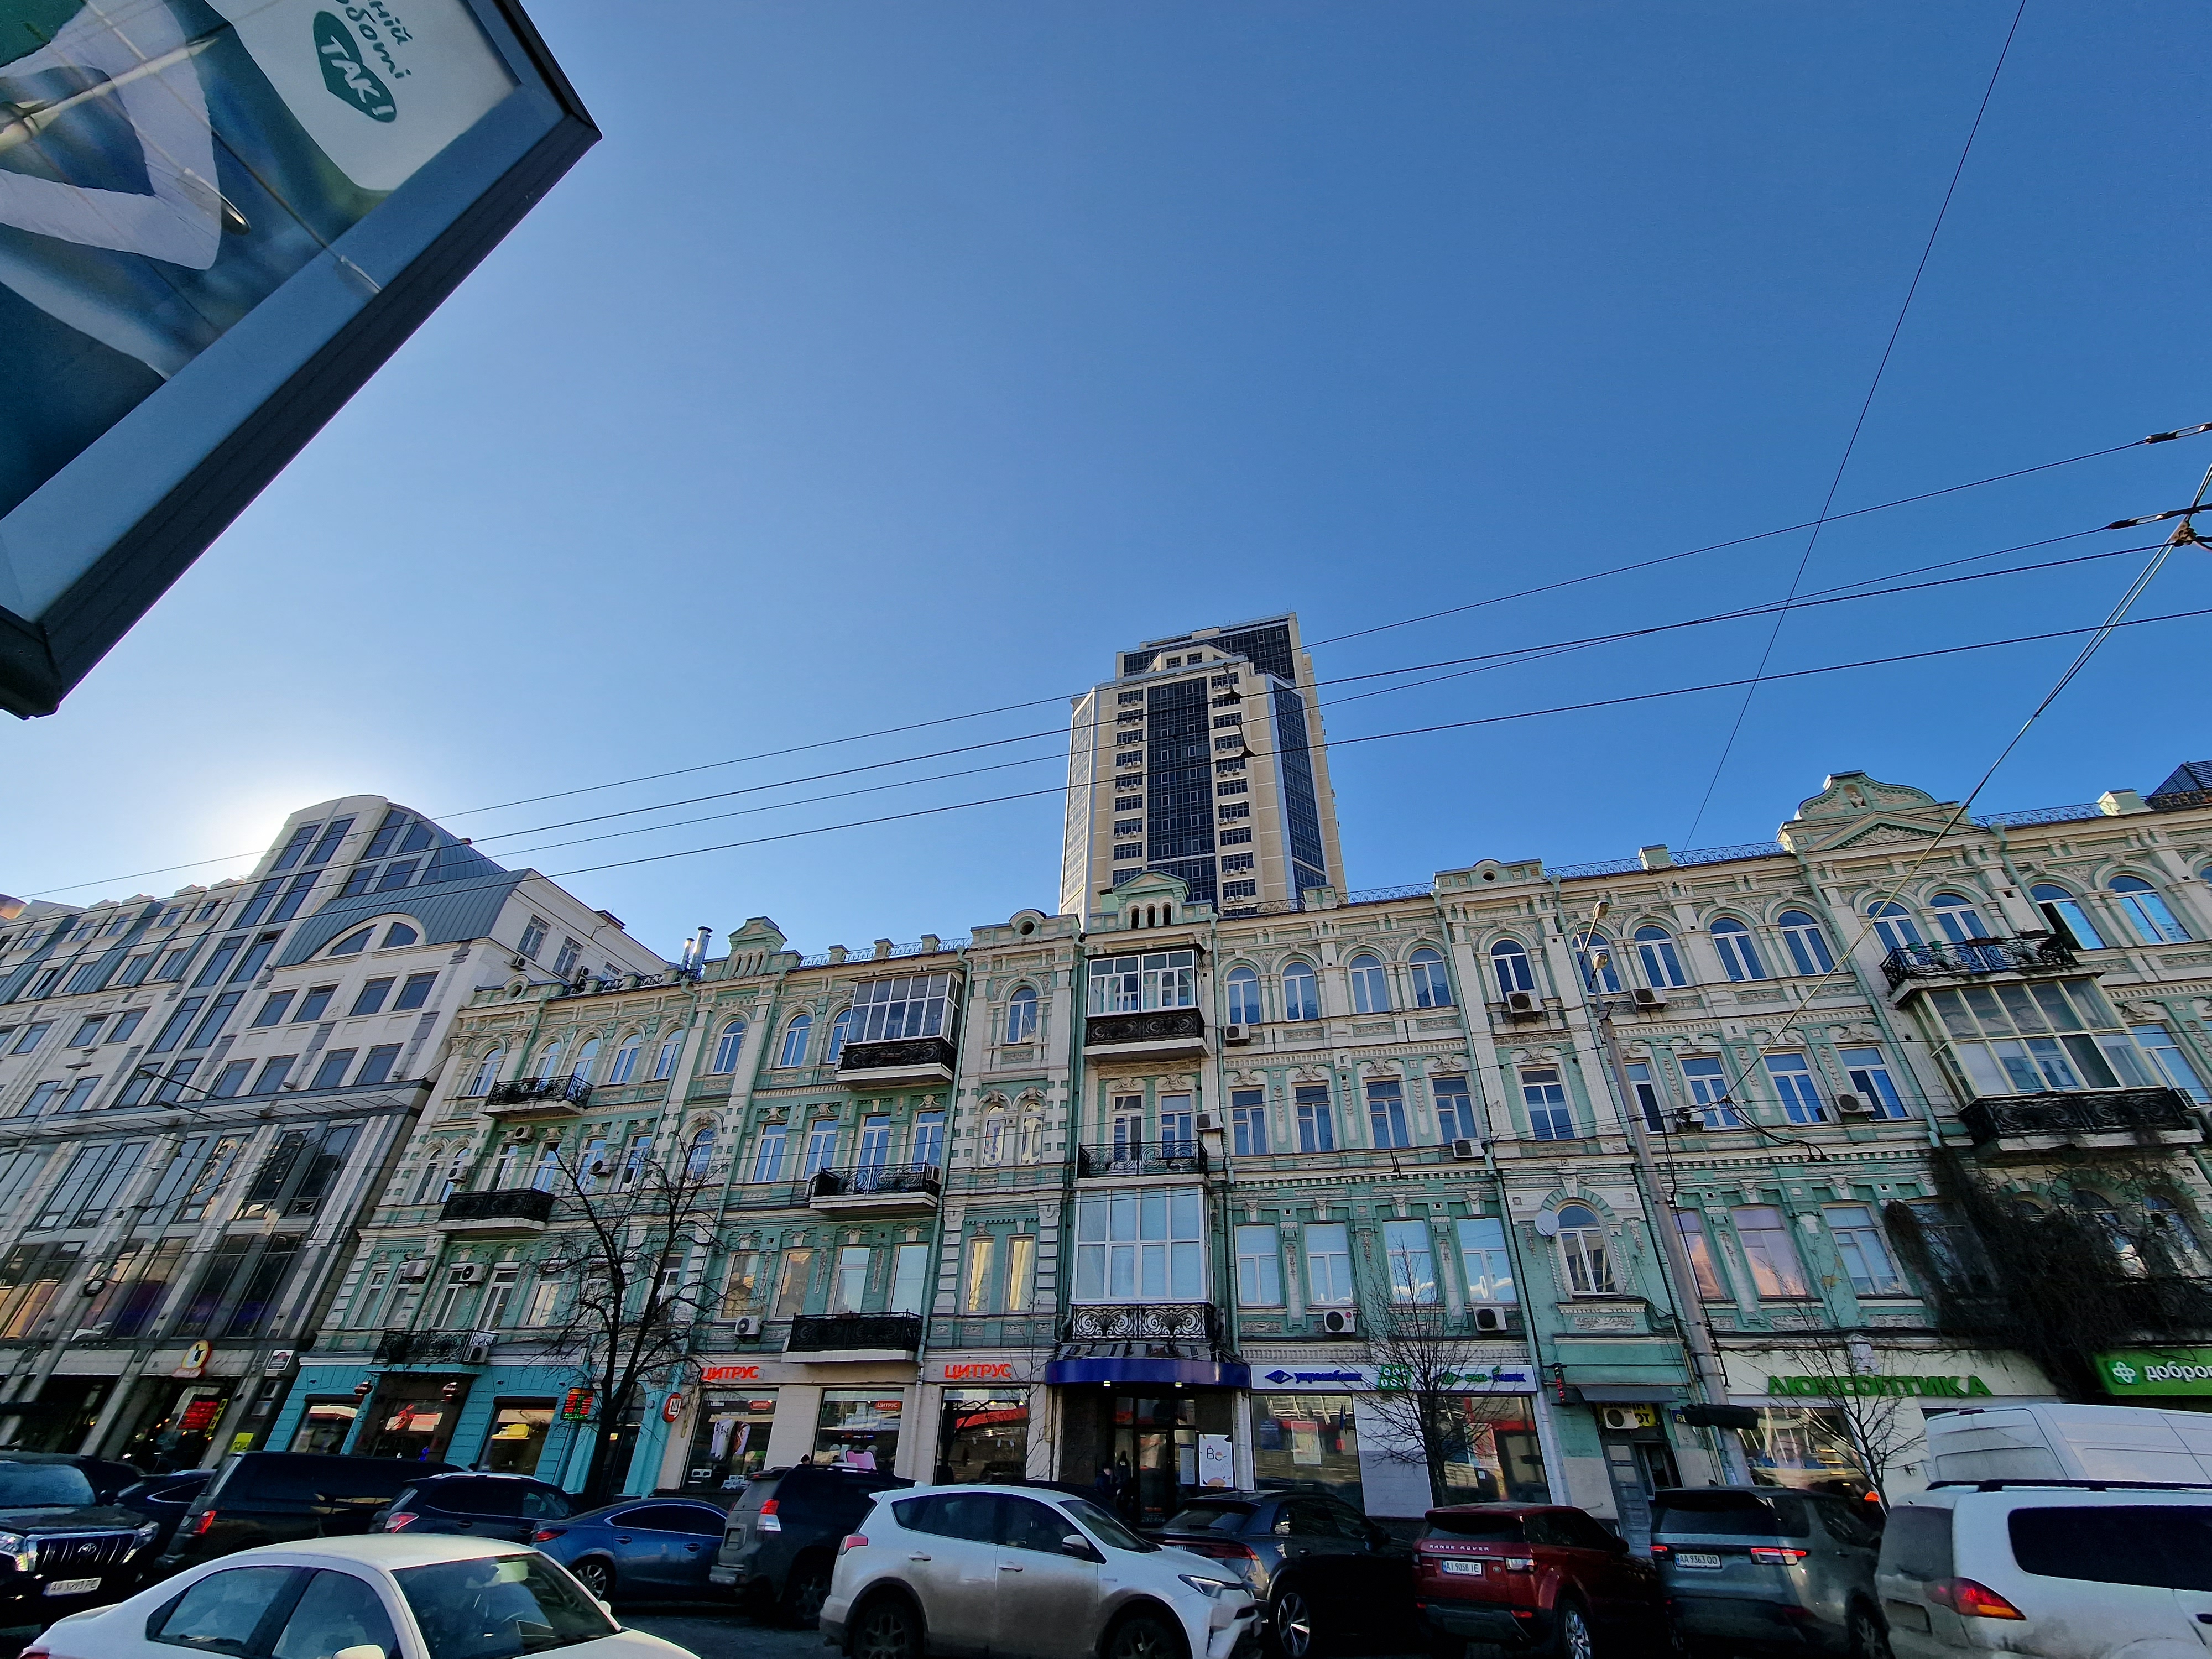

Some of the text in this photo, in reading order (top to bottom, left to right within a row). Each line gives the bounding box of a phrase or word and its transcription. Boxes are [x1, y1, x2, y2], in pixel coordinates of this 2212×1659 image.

[701, 1366, 760, 1380] ЦИТРУС
[945, 1363, 1012, 1379] ЦИТРУС
[1768, 1375, 1992, 1396] ЛЮКСОПТИКА
[1679, 1555, 1689, 1563] AA
[1690, 1556, 1705, 1564] 9363
[1446, 1562, 1479, 1573] AI 9058 IE
